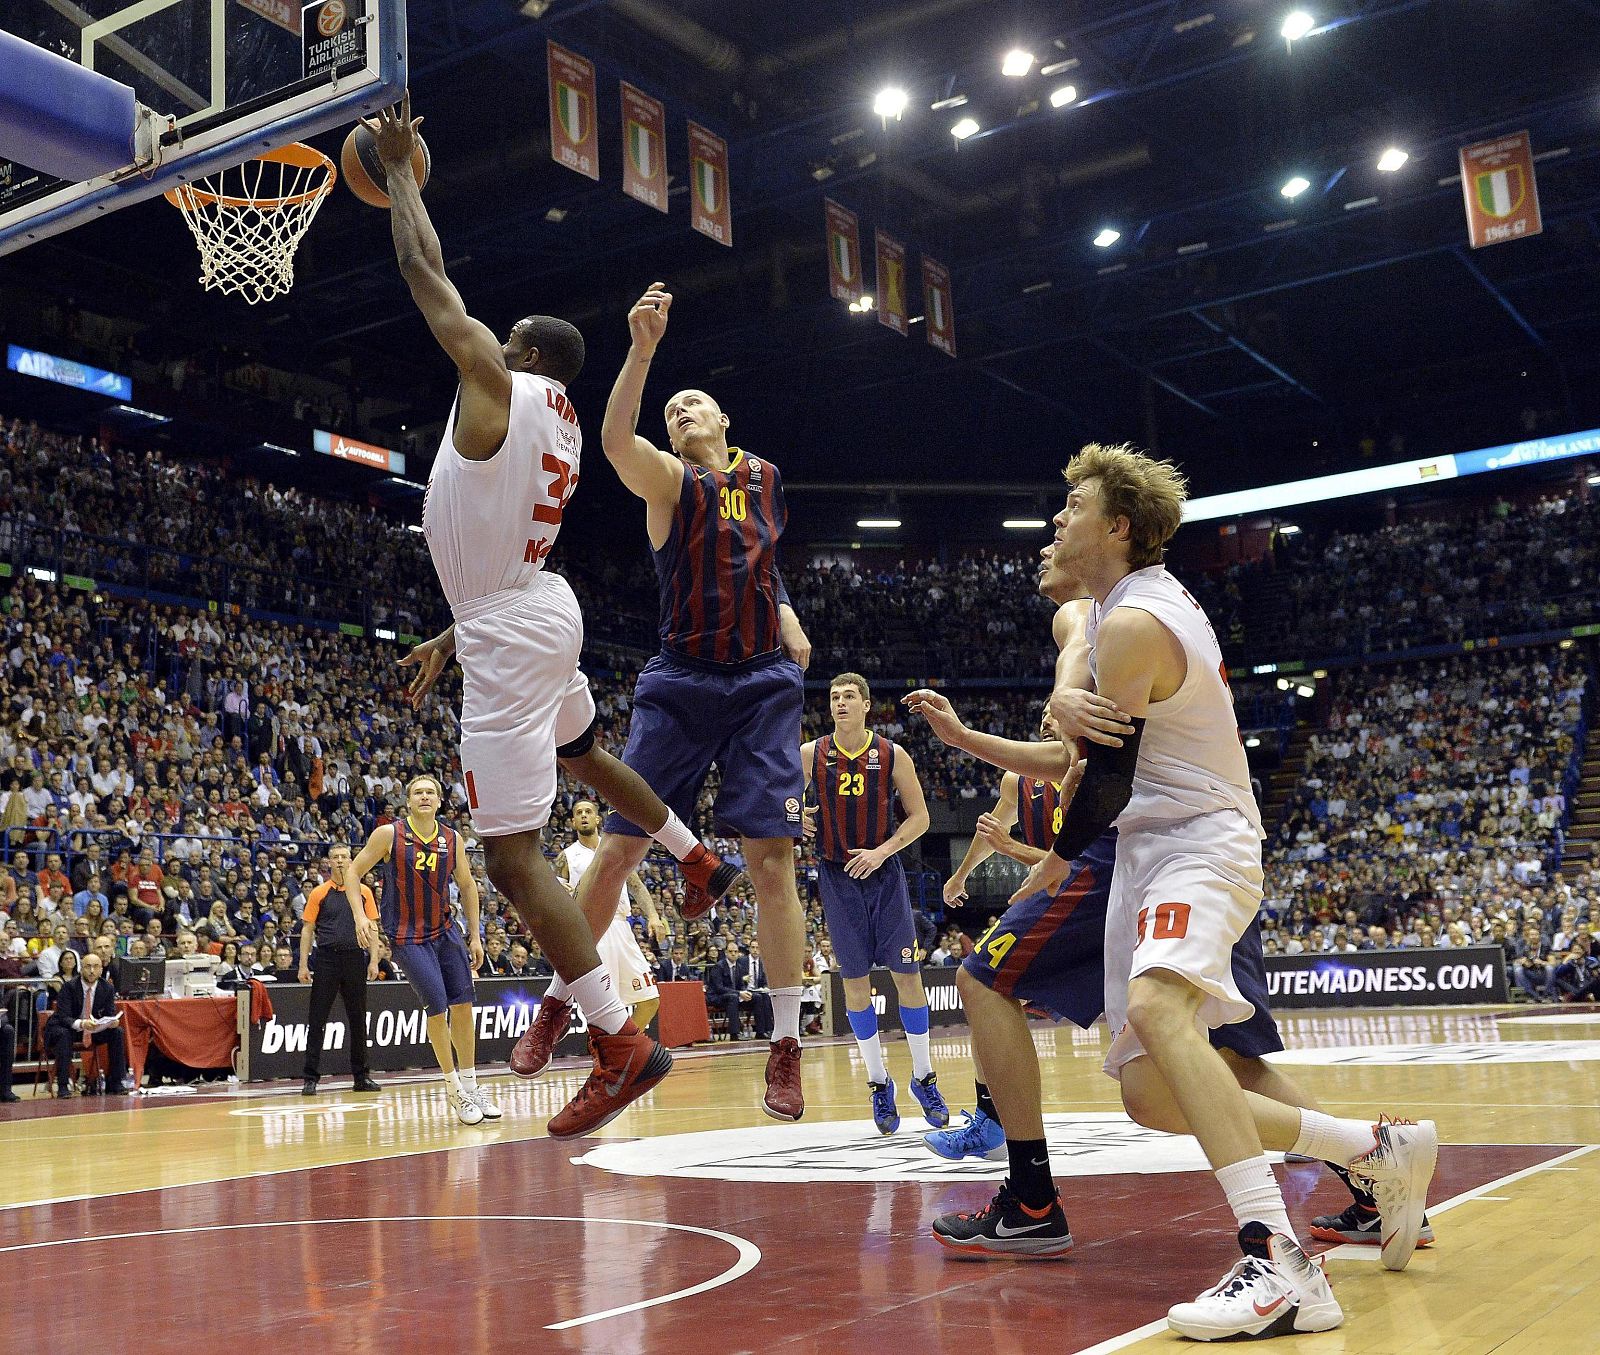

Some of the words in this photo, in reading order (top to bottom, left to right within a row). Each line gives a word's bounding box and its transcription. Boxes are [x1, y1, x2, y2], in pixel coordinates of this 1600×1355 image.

[308, 28, 356, 56] TURKISH
[308, 40, 356, 68] AIRLINES
[17, 352, 55, 379] AIR
[348, 446, 385, 464] AUTOGRILL
[719, 486, 747, 522] 30
[838, 772, 865, 796] 23
[415, 851, 438, 872] 24
[261, 1014, 345, 1054] bwn
